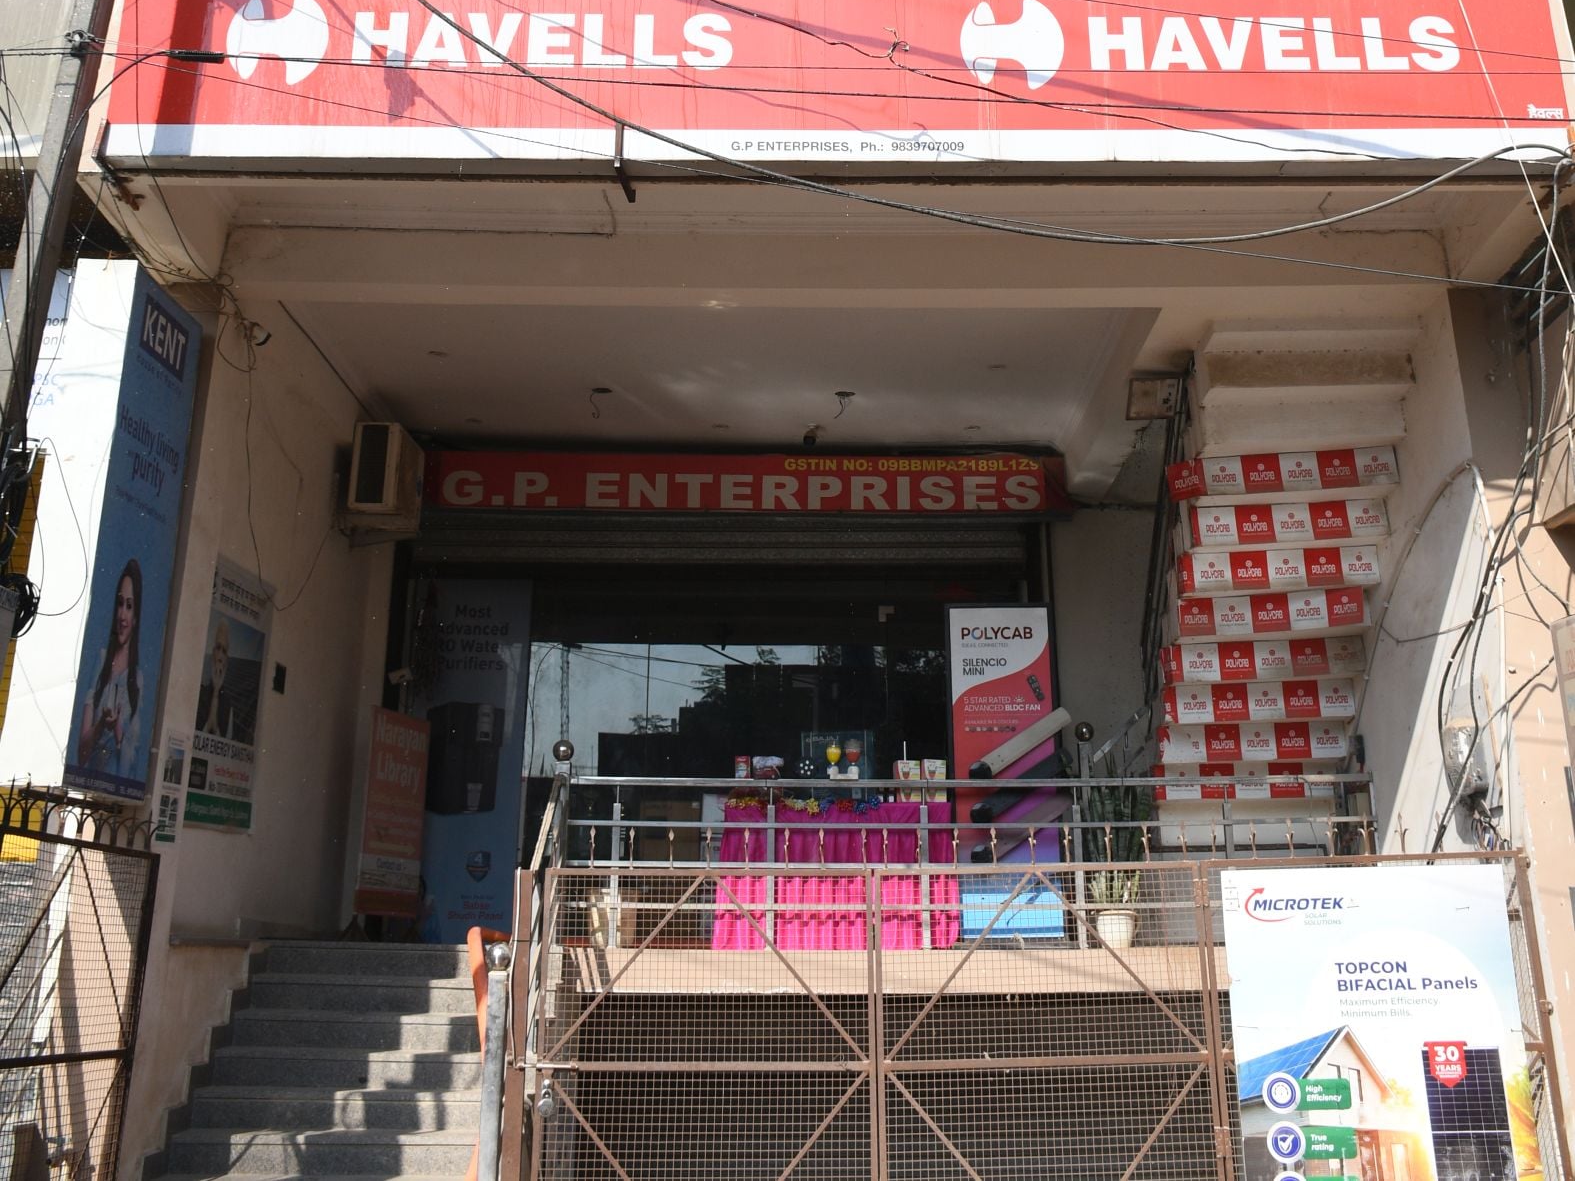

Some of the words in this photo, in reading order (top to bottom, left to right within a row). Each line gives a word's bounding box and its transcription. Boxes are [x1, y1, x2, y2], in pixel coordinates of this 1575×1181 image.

[351, 10, 735, 72] HAVELLS
[1087, 16, 1461, 72] HAVELLS
[731, 141, 753, 152] G.P
[757, 141, 853, 153] ENTERPRISES,
[891, 141, 964, 152] 9839707009
[143, 305, 187, 371] KENT
[120, 404, 156, 454] Healthy
[156, 431, 180, 474] living
[784, 459, 837, 472] GSTIN
[843, 459, 873, 471] NO:
[132, 452, 165, 497] purity
[442, 470, 559, 507] G.P.
[584, 473, 1041, 511] ENTERPRISES
[455, 604, 492, 618] Most
[436, 622, 510, 636] Advanced
[961, 626, 1033, 640] POLYCAB
[437, 655, 505, 671] Purifiers
[962, 657, 1007, 667] SILENCIO
[962, 667, 985, 676] MINI
[964, 696, 969, 704] 5
[969, 696, 988, 704] STAR
[988, 696, 1011, 704] RATED
[964, 704, 1004, 712] ADVANCED
[375, 715, 427, 754] Narayan
[376, 750, 421, 796] Library
[1253, 897, 1344, 912] MICROTEK
[1335, 961, 1408, 975] TOPCON
[1337, 978, 1417, 992] BIFACIAL
[1421, 976, 1478, 991] Panels
[1339, 998, 1388, 1006] Maximum
[1340, 1008, 1388, 1018] Minimum
[1433, 1045, 1460, 1062] 30
[1435, 1064, 1461, 1072] YEARS
[1305, 1085, 1323, 1093] High
[1306, 1094, 1342, 1102] Efficiency
[1311, 1144, 1334, 1152] rating
